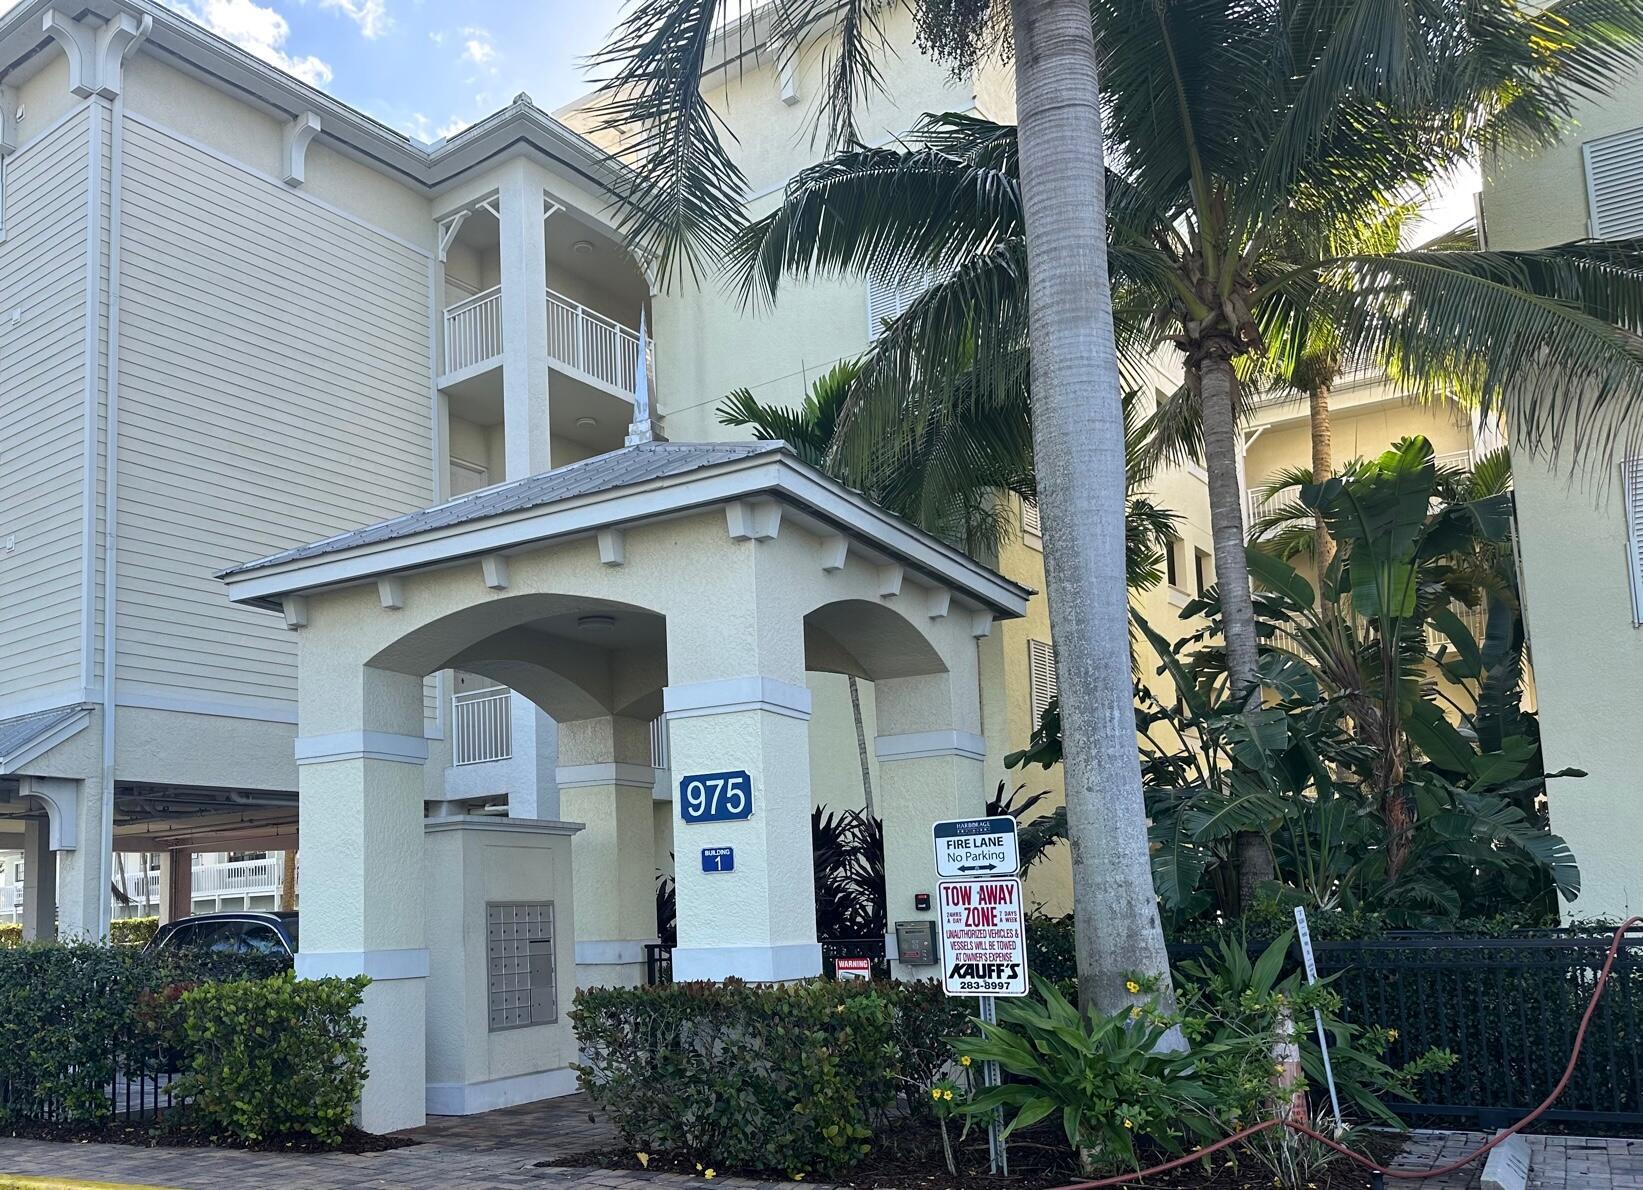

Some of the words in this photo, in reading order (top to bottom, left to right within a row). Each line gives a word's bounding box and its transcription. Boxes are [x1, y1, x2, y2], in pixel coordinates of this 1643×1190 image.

[687, 778, 745, 816] 975
[947, 839, 970, 849] FIRE
[974, 837, 1003, 847] LANE
[715, 856, 721, 870] 1
[948, 853, 962, 862] No
[966, 851, 1005, 862] Parking
[943, 886, 971, 906] TOW
[979, 884, 1014, 905] AWAY
[964, 907, 997, 927] ZONE
[946, 930, 987, 938] UNAUTHORIZED
[988, 929, 1013, 938] VEHICLES
[1015, 929, 1019, 938] &
[950, 941, 973, 950] VESSELS
[975, 941, 987, 950] WILL
[989, 941, 995, 950] BE
[997, 941, 1016, 950] TOWED
[956, 953, 961, 961] AT
[963, 953, 987, 961] OWNER'S
[989, 953, 1012, 961] EXPENSE
[949, 963, 1020, 979] KAUFF'S
